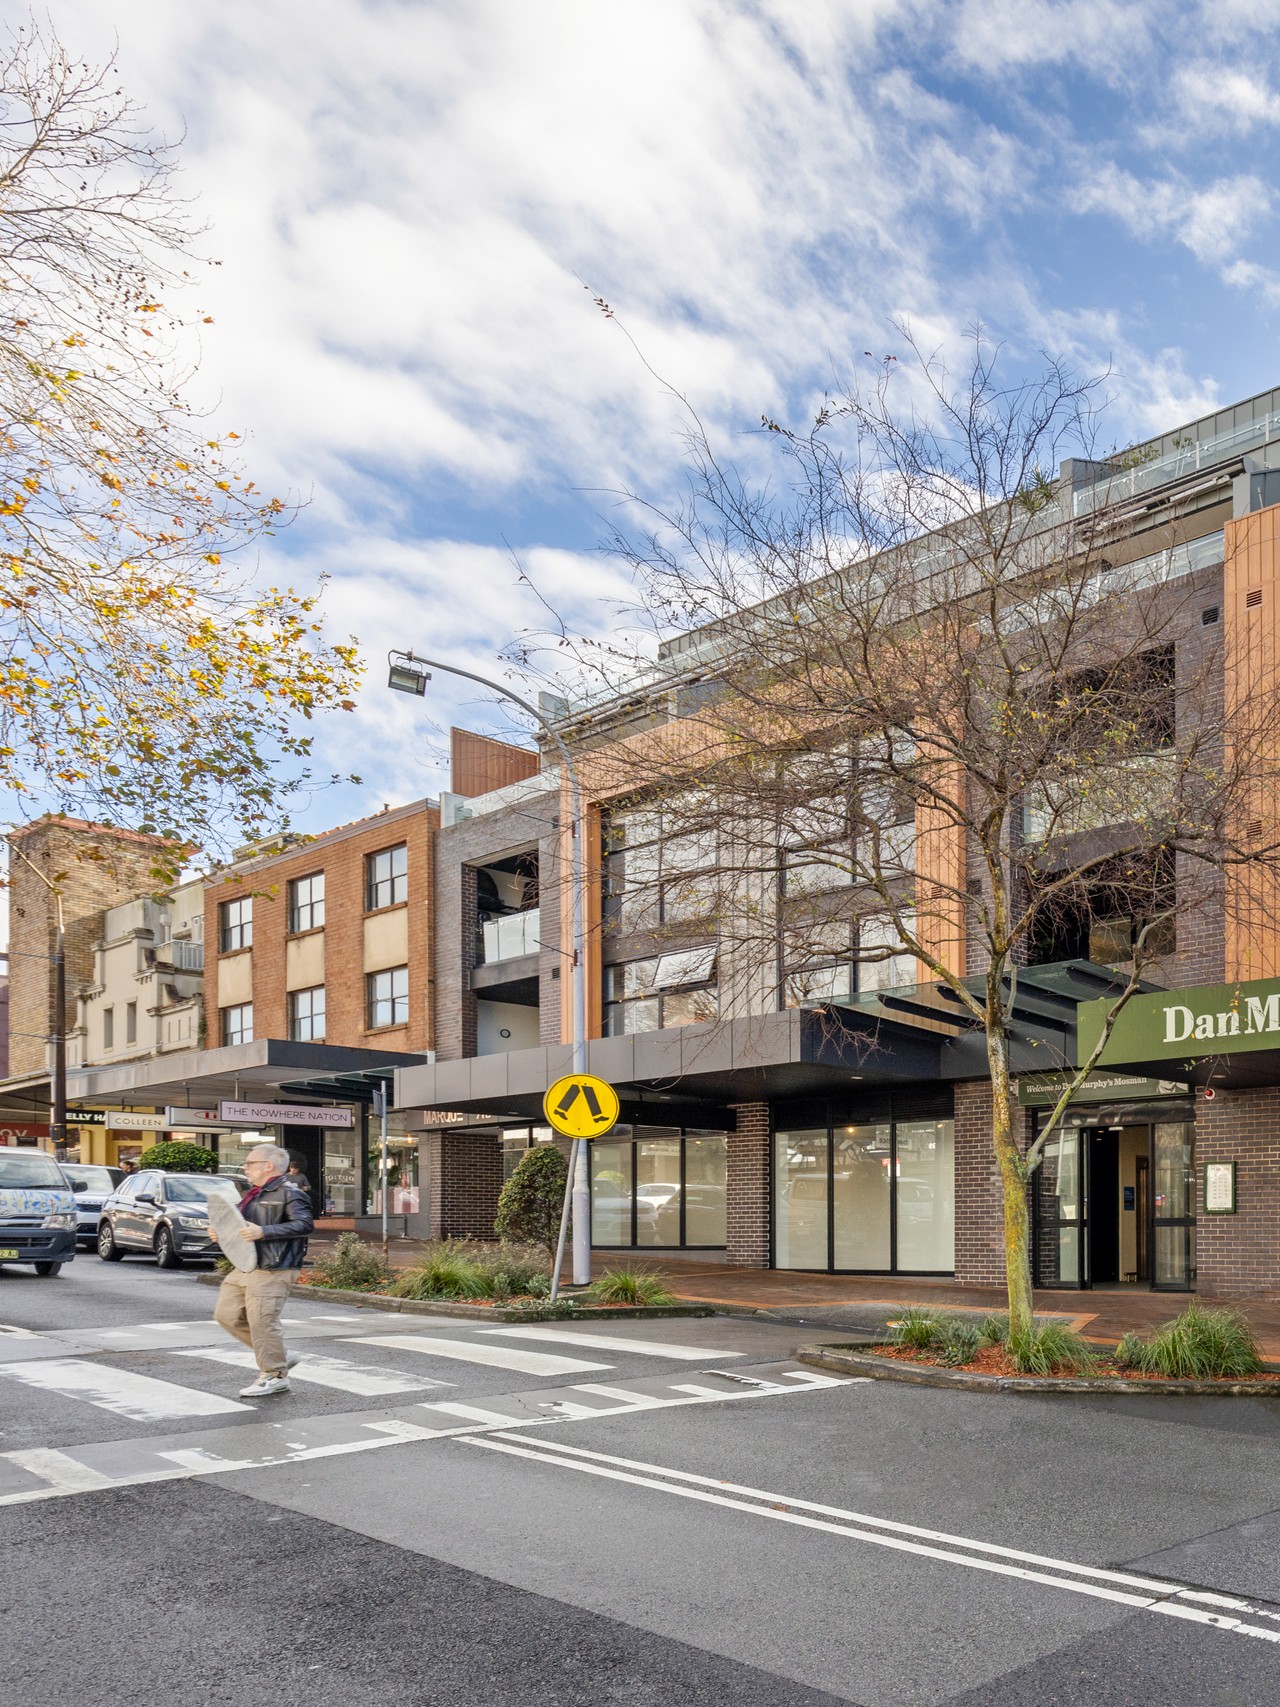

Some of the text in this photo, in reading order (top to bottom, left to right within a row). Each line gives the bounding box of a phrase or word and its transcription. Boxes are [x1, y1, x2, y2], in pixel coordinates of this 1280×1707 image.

[1026, 1084, 1054, 1093] Welcome
[1113, 1077, 1147, 1087] Mosman
[66, 1112, 93, 1121] ELLY
[226, 1107, 348, 1122] THE NOWHERE NATION
[115, 1117, 162, 1126] COLLEEN
